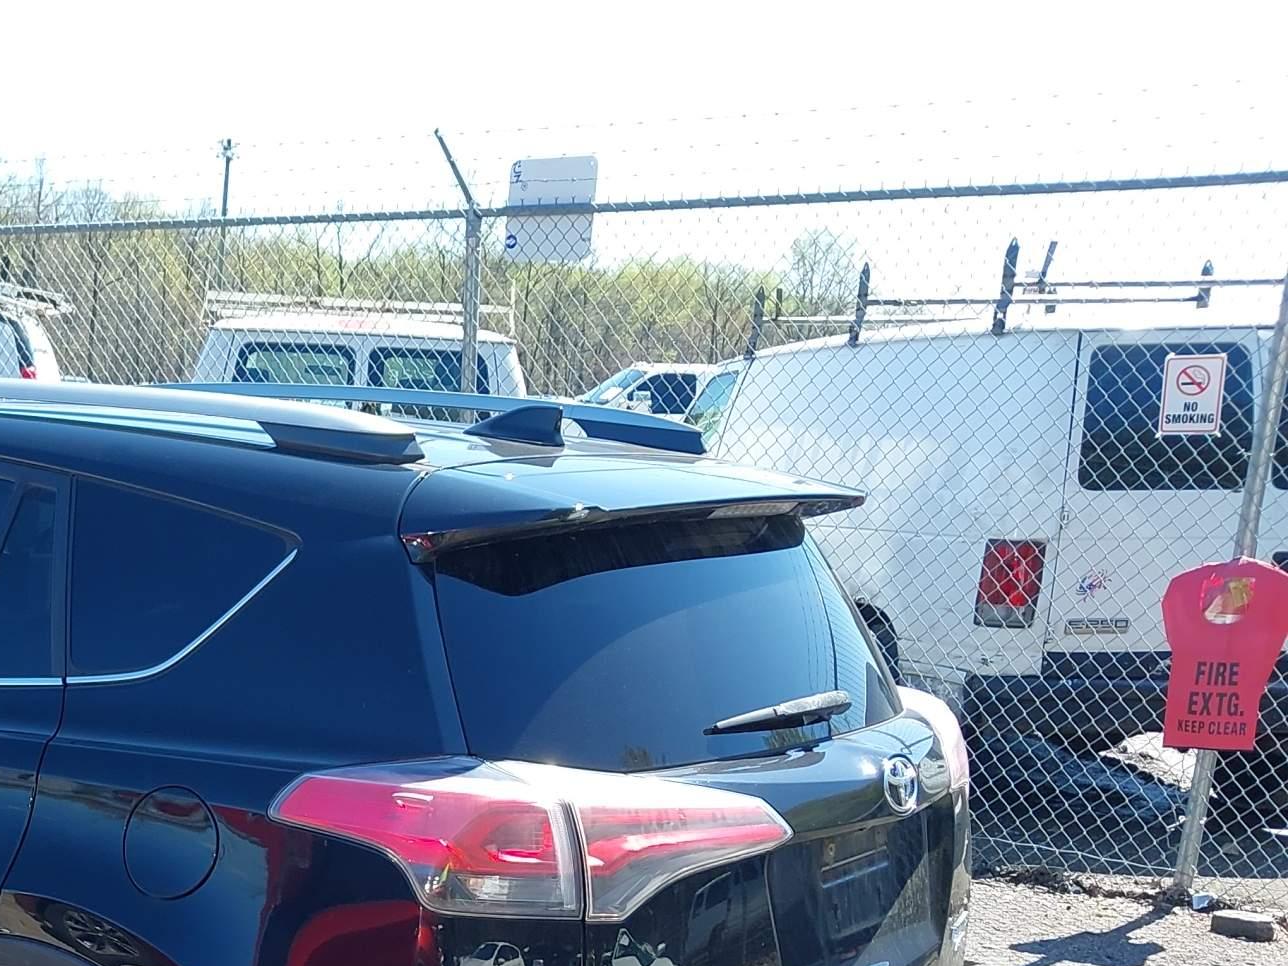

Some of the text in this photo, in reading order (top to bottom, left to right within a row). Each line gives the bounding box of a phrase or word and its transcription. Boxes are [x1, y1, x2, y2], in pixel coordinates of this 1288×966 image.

[1183, 401, 1199, 412] NO
[1164, 413, 1215, 424] SMOKING
[1195, 661, 1240, 686] FIRE
[1187, 691, 1244, 716] EXTG.
[1177, 719, 1247, 736] KEEP CLEAR
